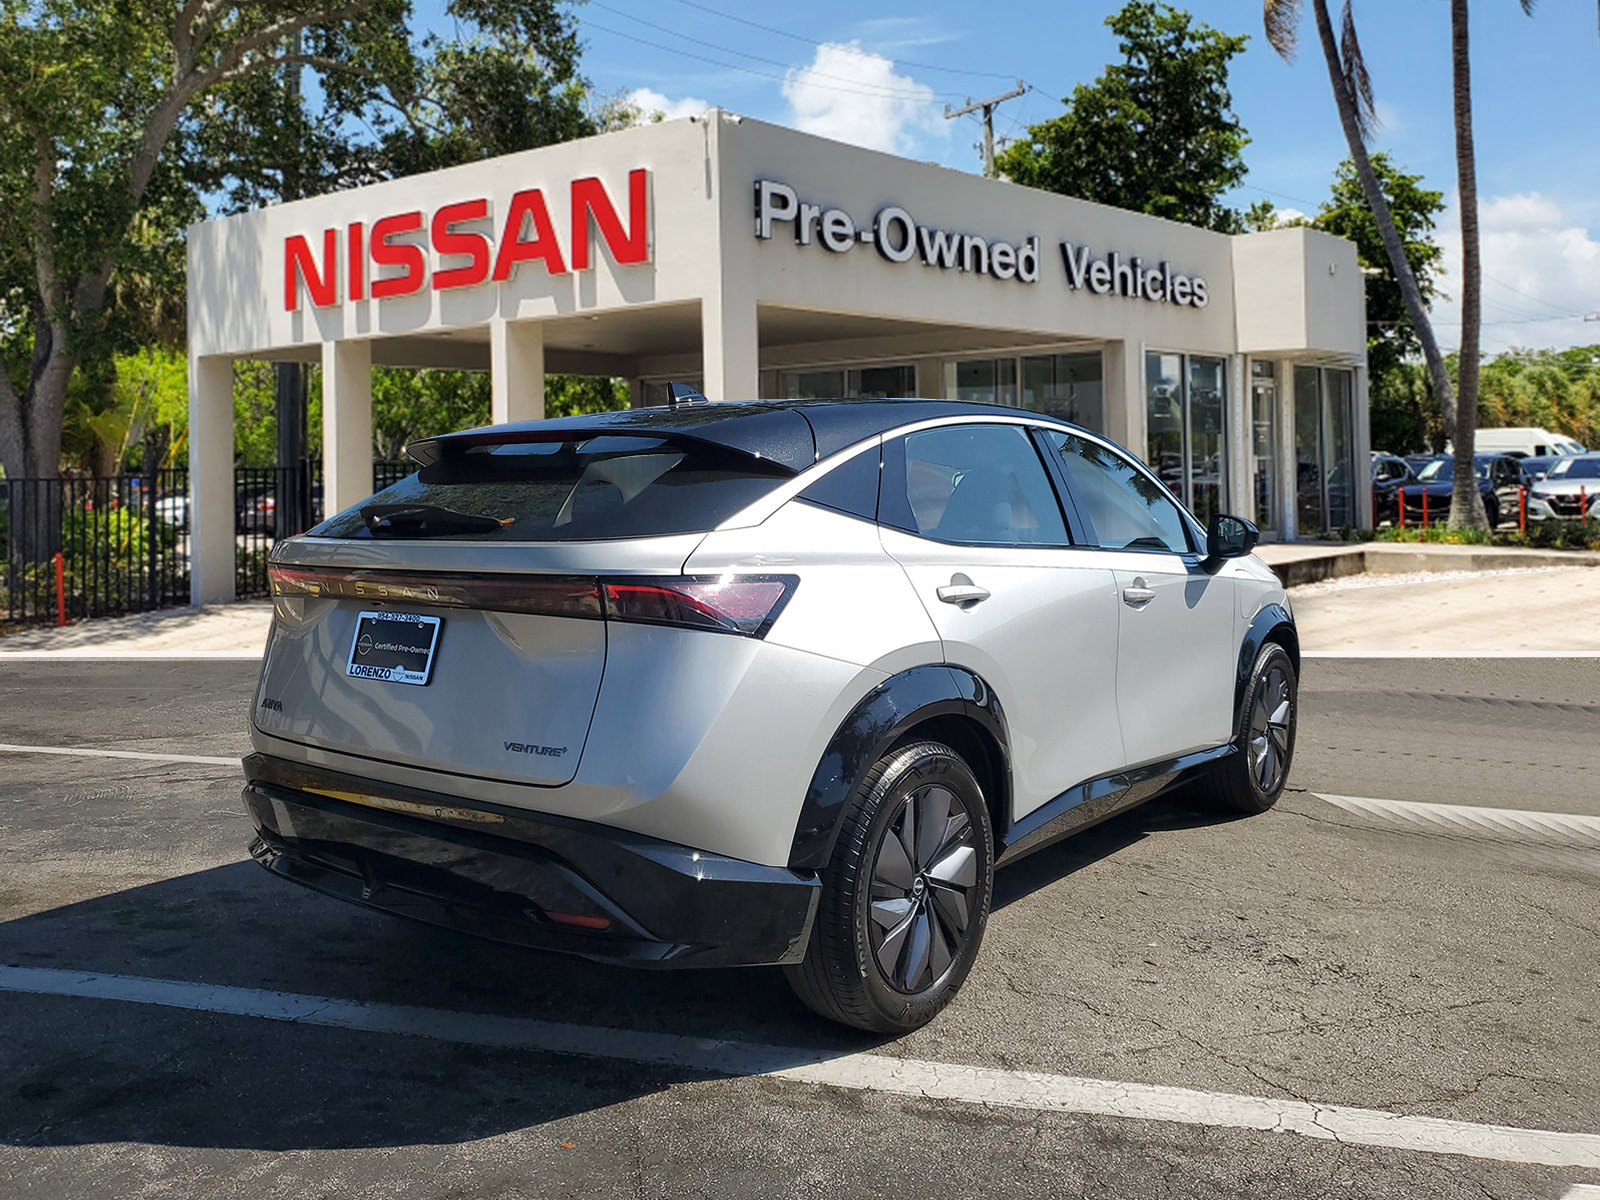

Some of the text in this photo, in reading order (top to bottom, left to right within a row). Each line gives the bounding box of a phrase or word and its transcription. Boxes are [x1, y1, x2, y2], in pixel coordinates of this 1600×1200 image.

[283, 168, 649, 313] NISSAN
[754, 179, 1210, 309] Pre-Owned Vehicles
[318, 581, 440, 601] NISSAN
[374, 642, 398, 652] Certified
[349, 665, 392, 680] LORENZO
